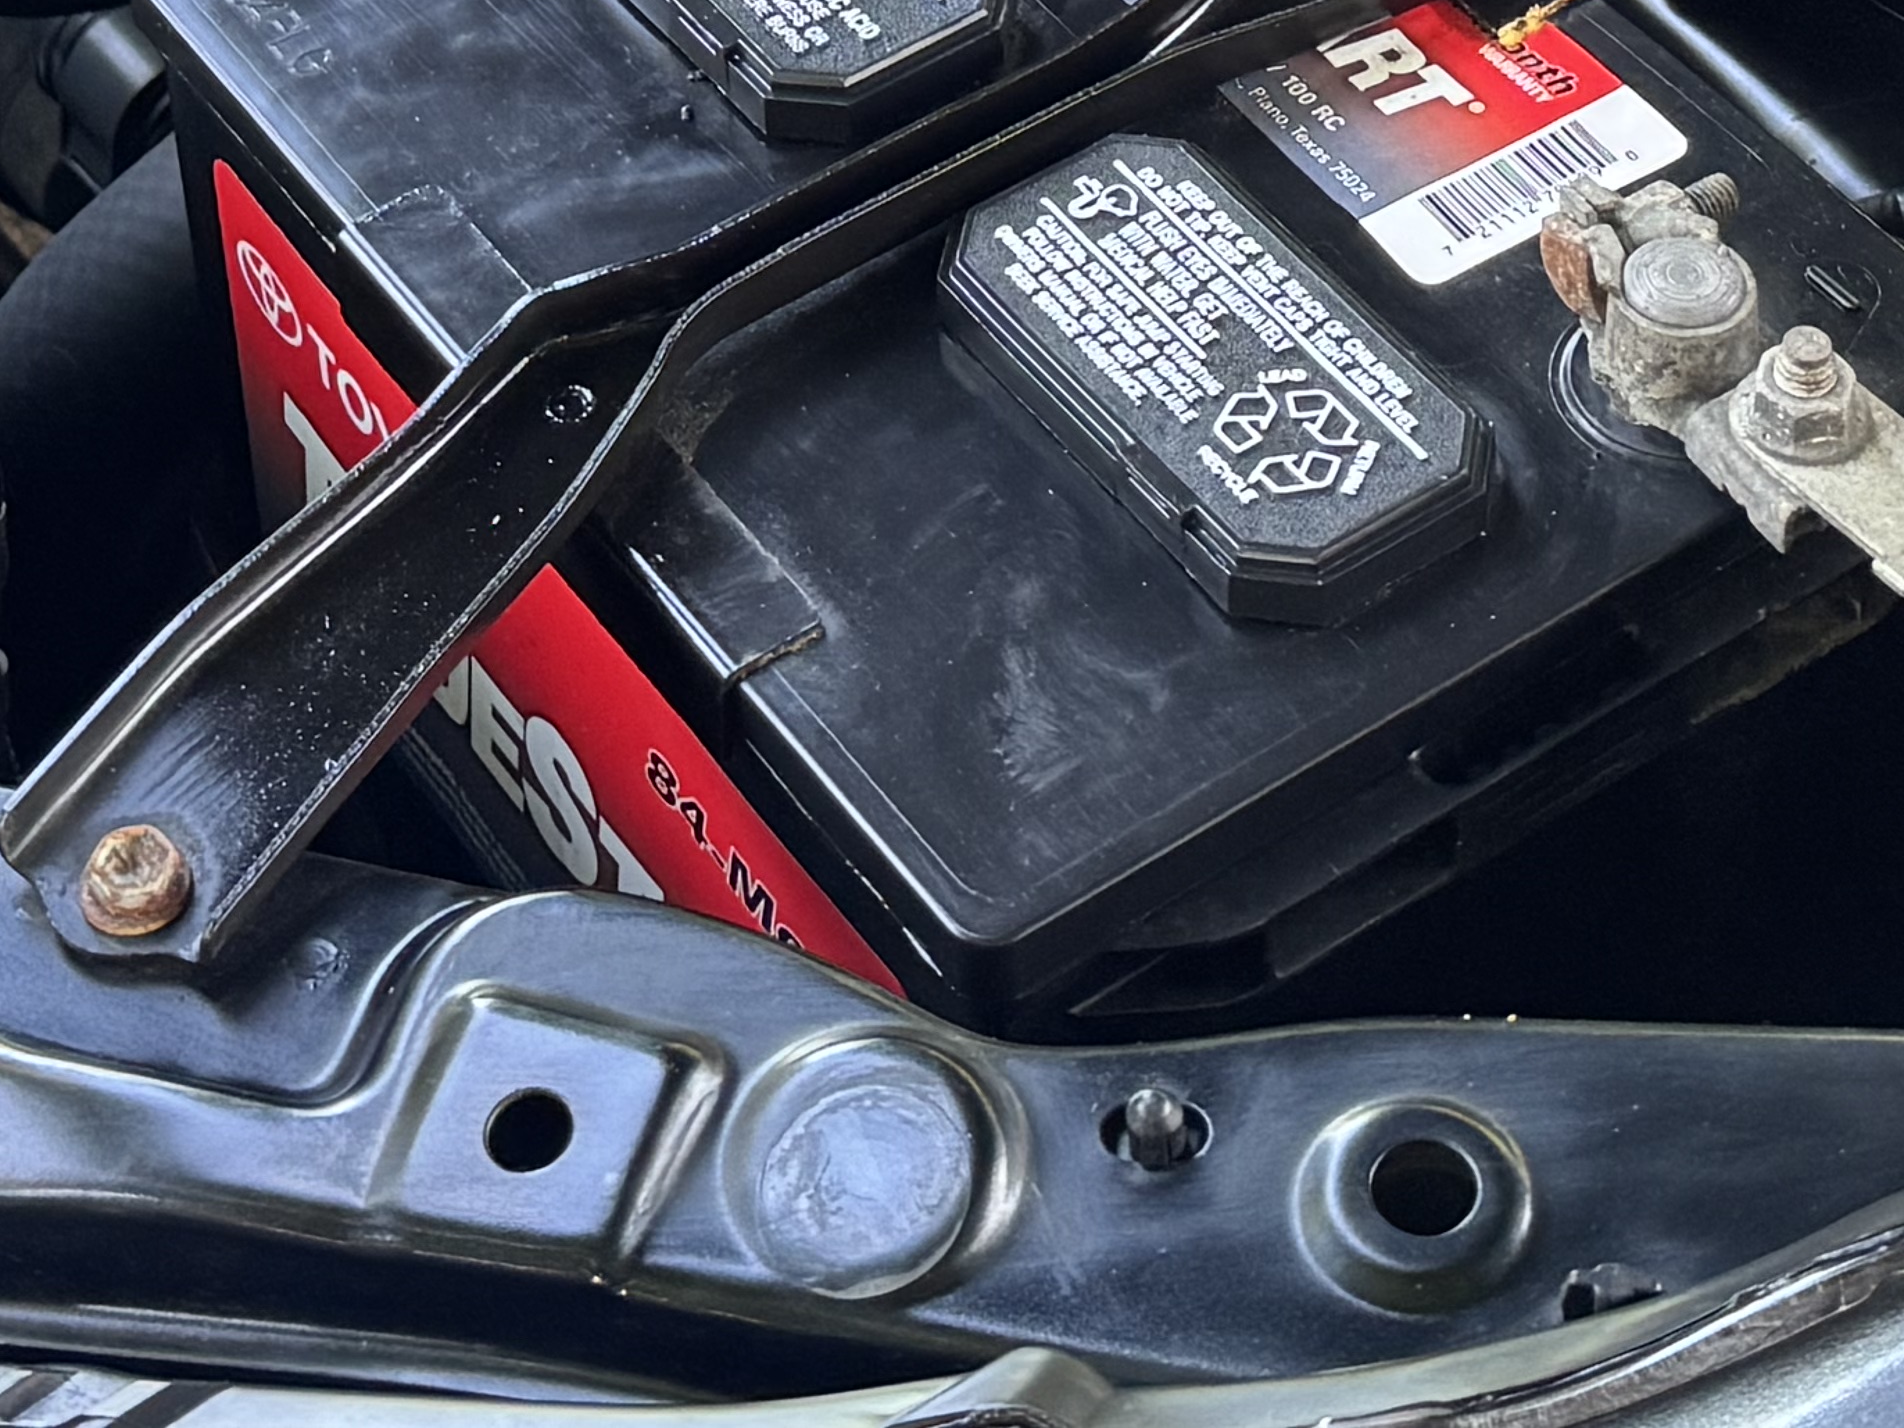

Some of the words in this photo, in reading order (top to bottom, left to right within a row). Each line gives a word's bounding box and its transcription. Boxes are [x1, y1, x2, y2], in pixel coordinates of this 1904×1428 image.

[765, 15, 809, 52] BURNS
[804, 26, 829, 46] OR
[839, 8, 881, 42] ACID
[1498, 40, 1580, 98] onth
[1280, 74, 1317, 105] 100
[1310, 103, 1347, 132] RC
[1316, 26, 1475, 116] RT
[1289, 123, 1332, 165] Texas
[1327, 160, 1377, 204] 75024
[1094, 233, 1155, 287] MEDICAL
[1146, 281, 1188, 313] HELP
[1171, 311, 1220, 345] FAST
[1118, 221, 1160, 256] WITH
[1193, 293, 1229, 320] GET
[1131, 166, 1163, 188] DO
[1150, 185, 1196, 212] NOT
[1202, 234, 1247, 265] KEEP
[1234, 265, 1282, 298] VENT
[1268, 297, 1317, 331] CAPS
[1304, 329, 1357, 366] TIGHT
[1344, 367, 1386, 395] AND
[1369, 393, 1419, 433] LEVEL
[1139, 210, 1187, 251] FLUSH
[1177, 246, 1217, 280] EYES
[1207, 276, 1302, 352] IMMEDIATELY
[1170, 180, 1216, 210] KEEP
[1201, 210, 1244, 238] OUT
[1230, 237, 1263, 254] OF
[1251, 253, 1289, 283] THE
[1276, 279, 1329, 322] REACH
[1323, 320, 1351, 338] OF
[1338, 338, 1412, 398] CHILDREN
[1106, 284, 1142, 316] SAFE
[1163, 341, 1224, 396] STARTING
